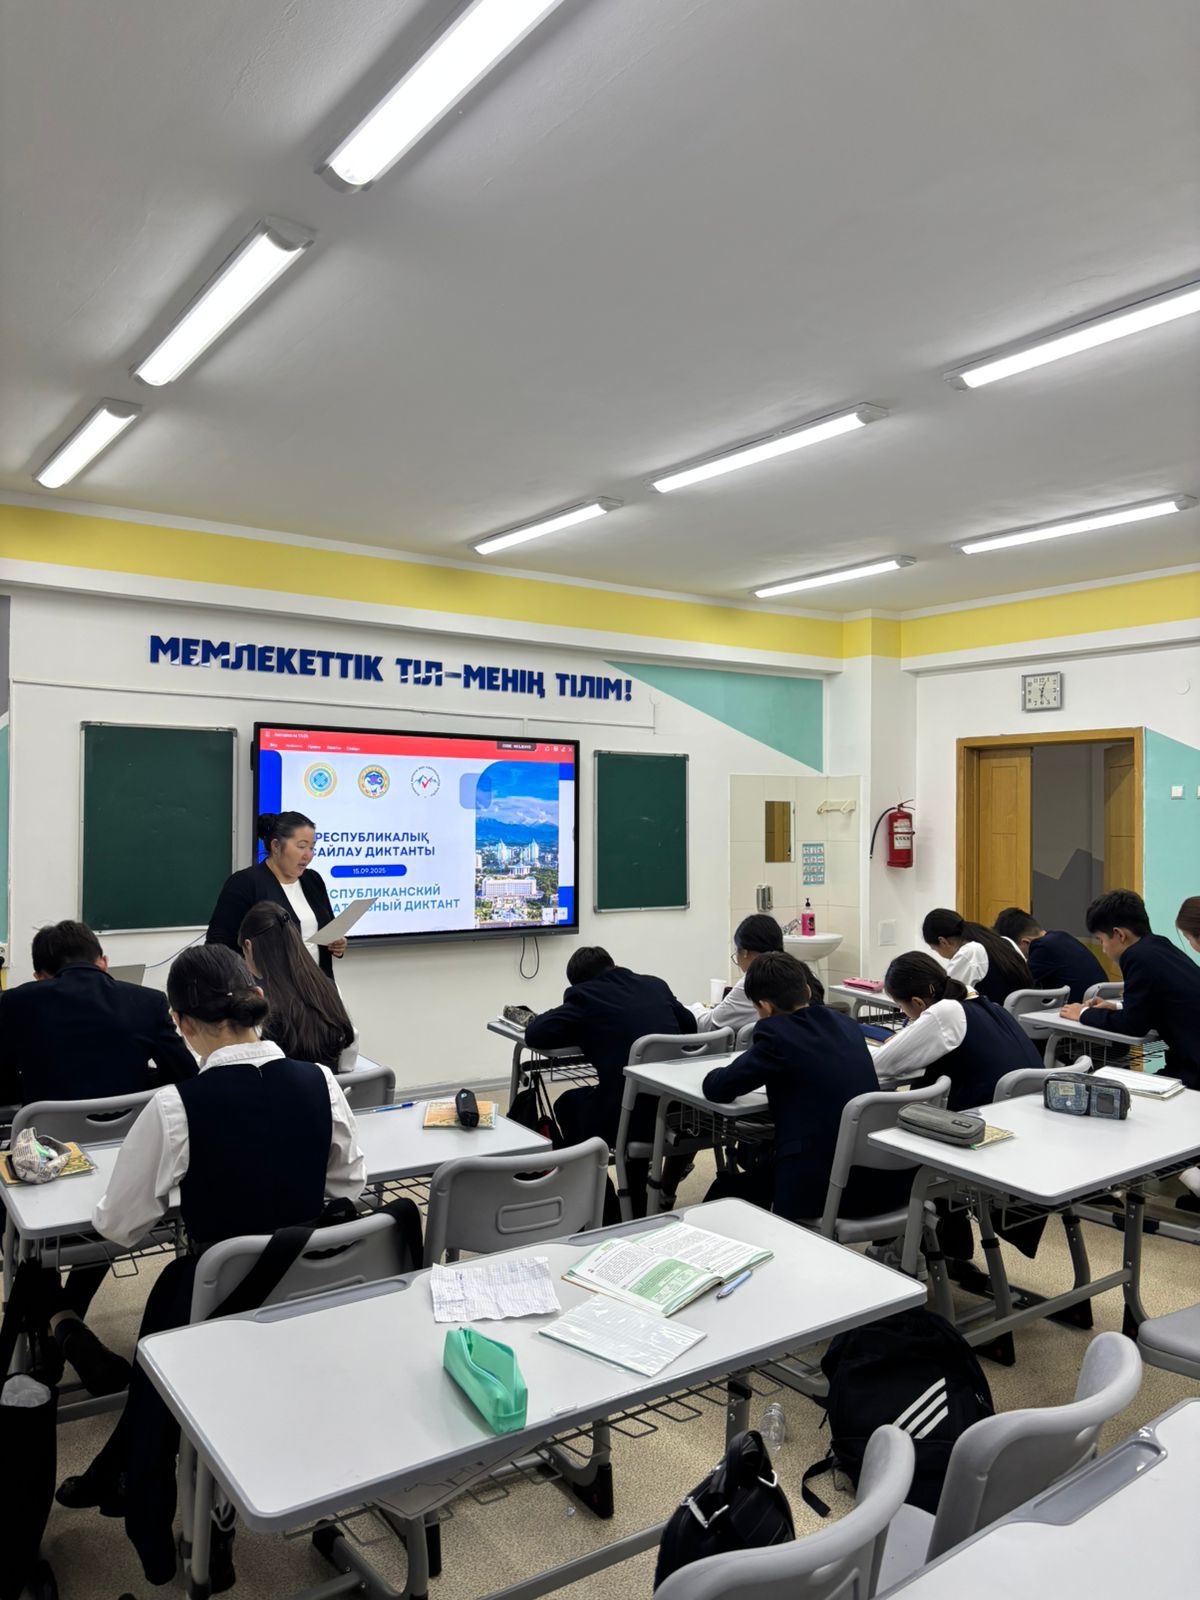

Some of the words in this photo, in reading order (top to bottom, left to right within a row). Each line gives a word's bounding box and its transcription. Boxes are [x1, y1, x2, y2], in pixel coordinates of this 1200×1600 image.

[150, 635, 383, 681] МЕМЛЕКЕТТІК
[556, 673, 632, 702] ТІЛІМ!
[315, 832, 429, 844] РЕСПУБЛИКАЛЫҚ
[365, 846, 435, 858] ДИКТАНТЫ
[352, 867, 387, 875] 15.09.2025
[328, 884, 440, 899] СПУБЛИКАНСКИЙ
[404, 898, 460, 912] ДИКТАНТ
